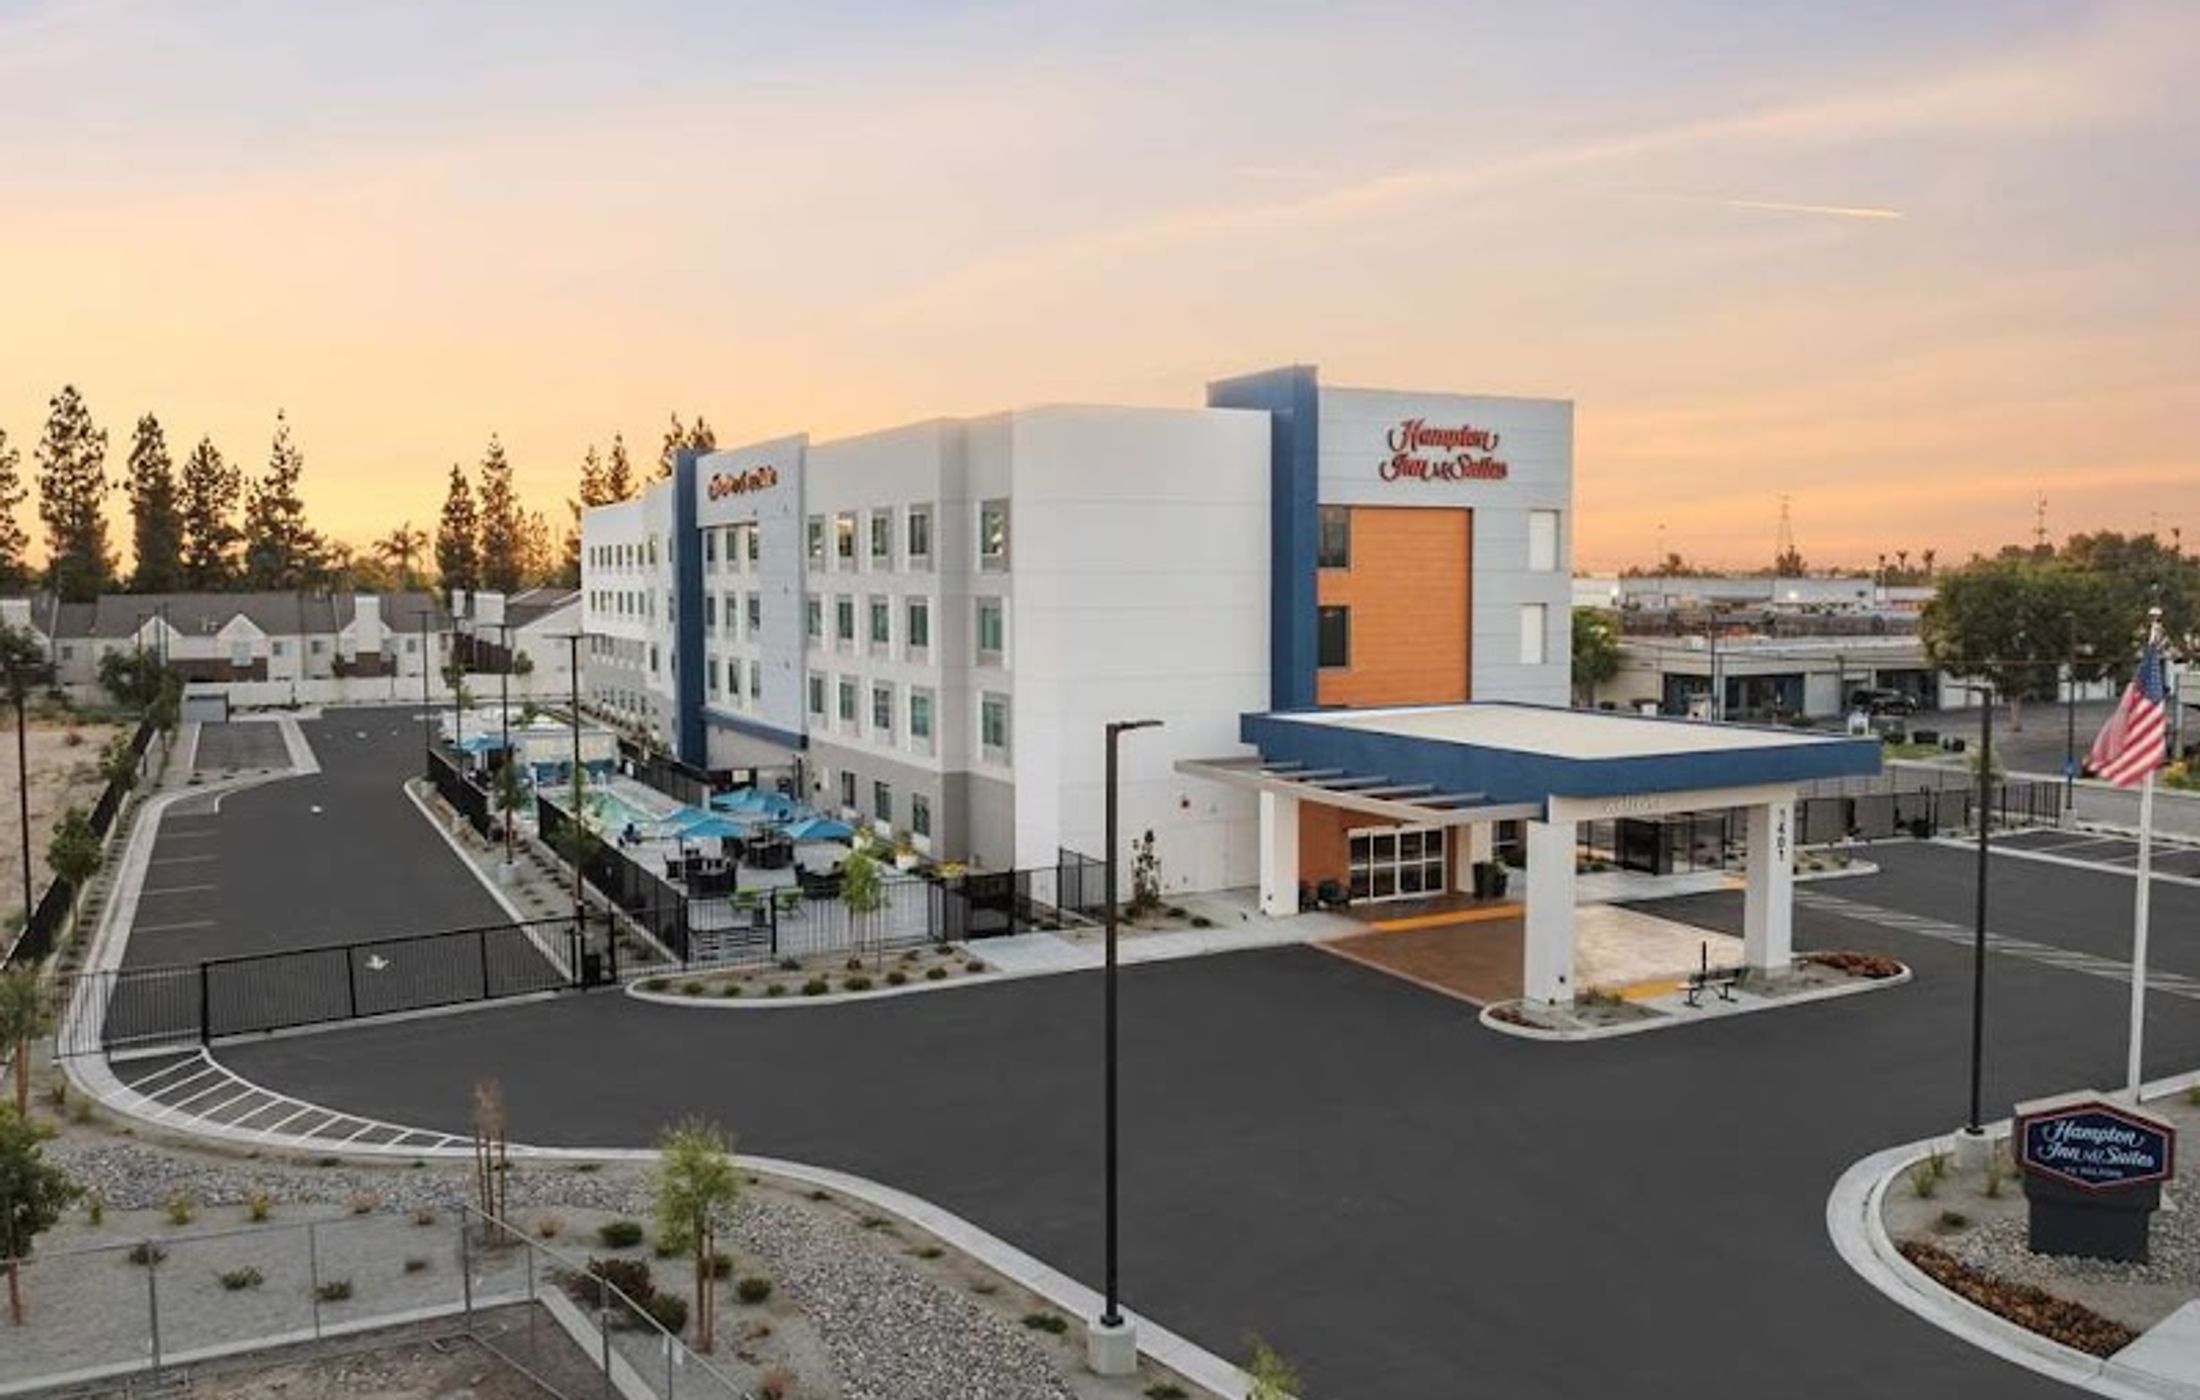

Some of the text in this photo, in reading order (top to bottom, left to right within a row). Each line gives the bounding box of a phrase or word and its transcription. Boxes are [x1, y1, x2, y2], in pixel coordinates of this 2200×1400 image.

[1387, 418, 1499, 452] Hampton
[1379, 453, 1437, 482] Inn
[1450, 454, 1508, 480] Suites
[2042, 1120, 2145, 1148] Hampton
[2037, 1141, 2087, 1162] Inn
[2098, 1146, 2155, 1168] Suites
